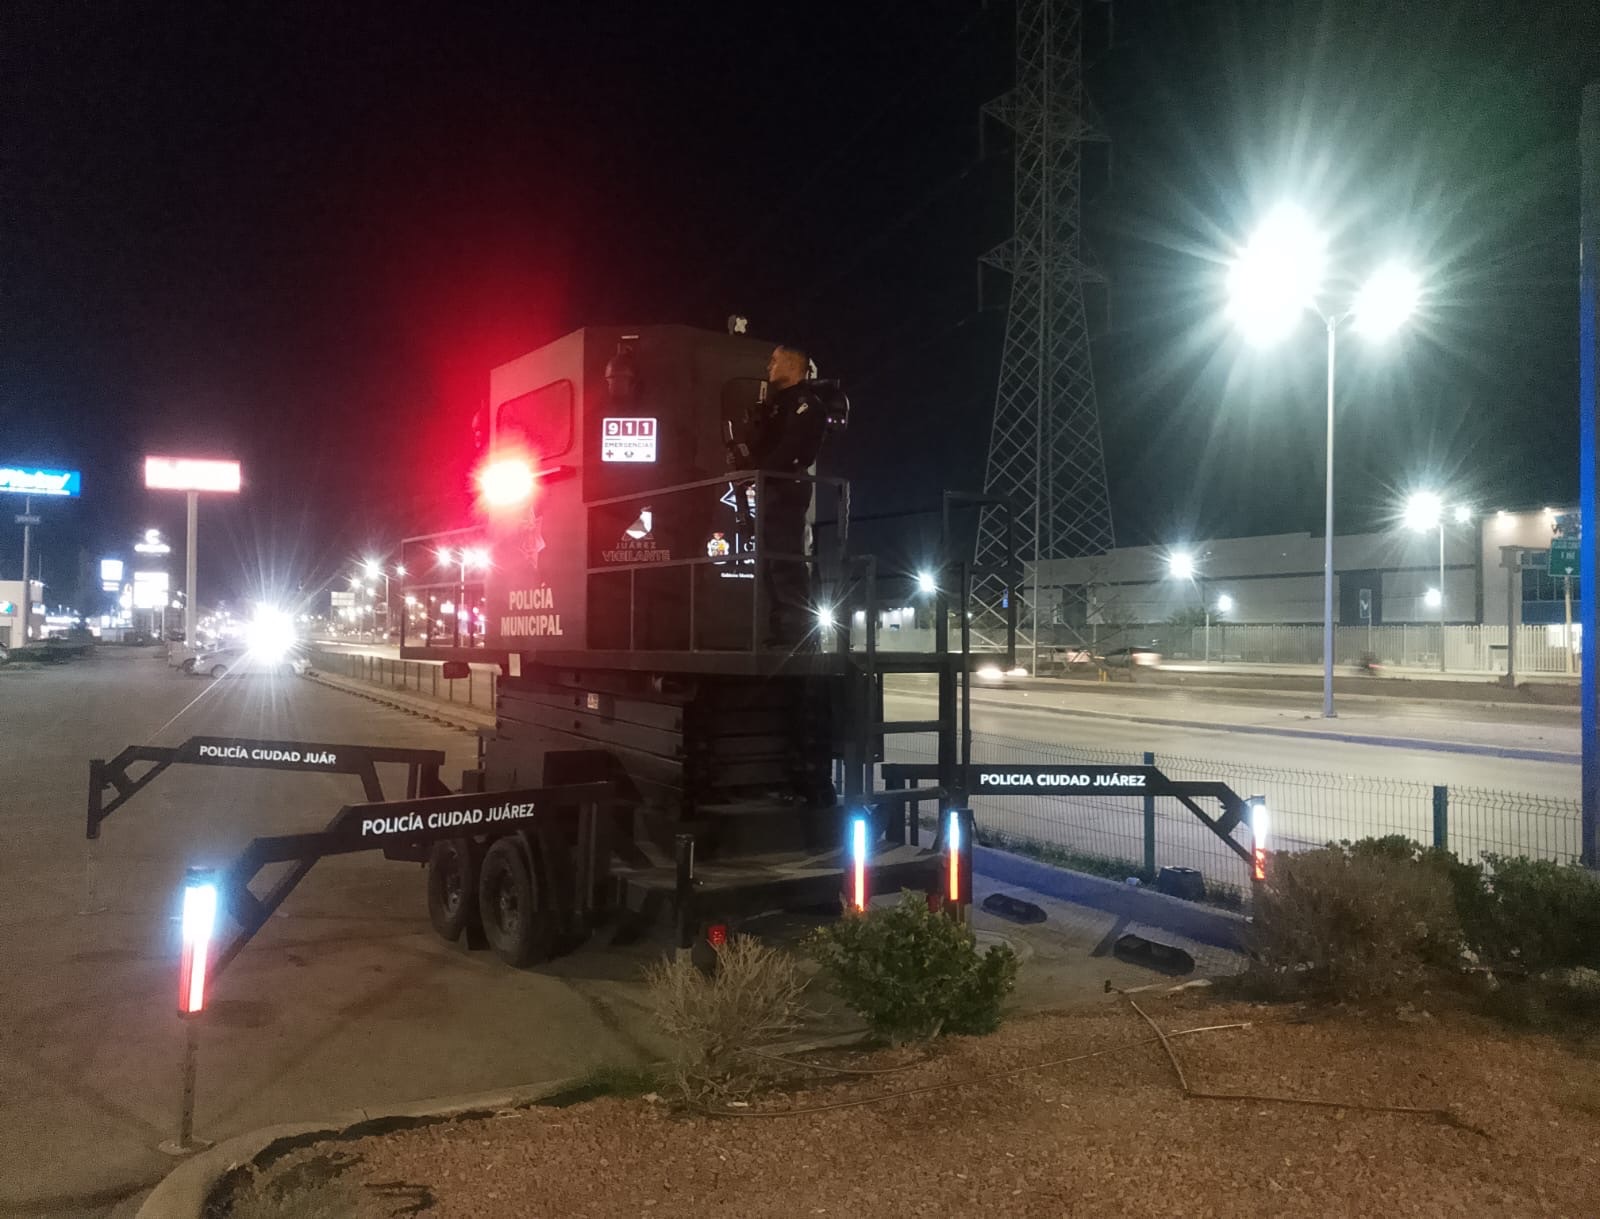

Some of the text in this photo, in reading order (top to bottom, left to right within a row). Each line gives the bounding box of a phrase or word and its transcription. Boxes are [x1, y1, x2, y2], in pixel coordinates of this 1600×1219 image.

[607, 421, 651, 436] 911
[602, 550, 671, 562] VIGILANTE
[509, 582, 554, 611] POLICÍA
[501, 614, 563, 637] MUNICIPAL
[199, 745, 337, 765] POLICÍA CIUDAD JUÁR
[1036, 774, 1091, 786] CIUDAD
[1093, 772, 1146, 787] JUÁREZ
[361, 802, 535, 837] POLICÍA CIUDAD JUÁREZ
